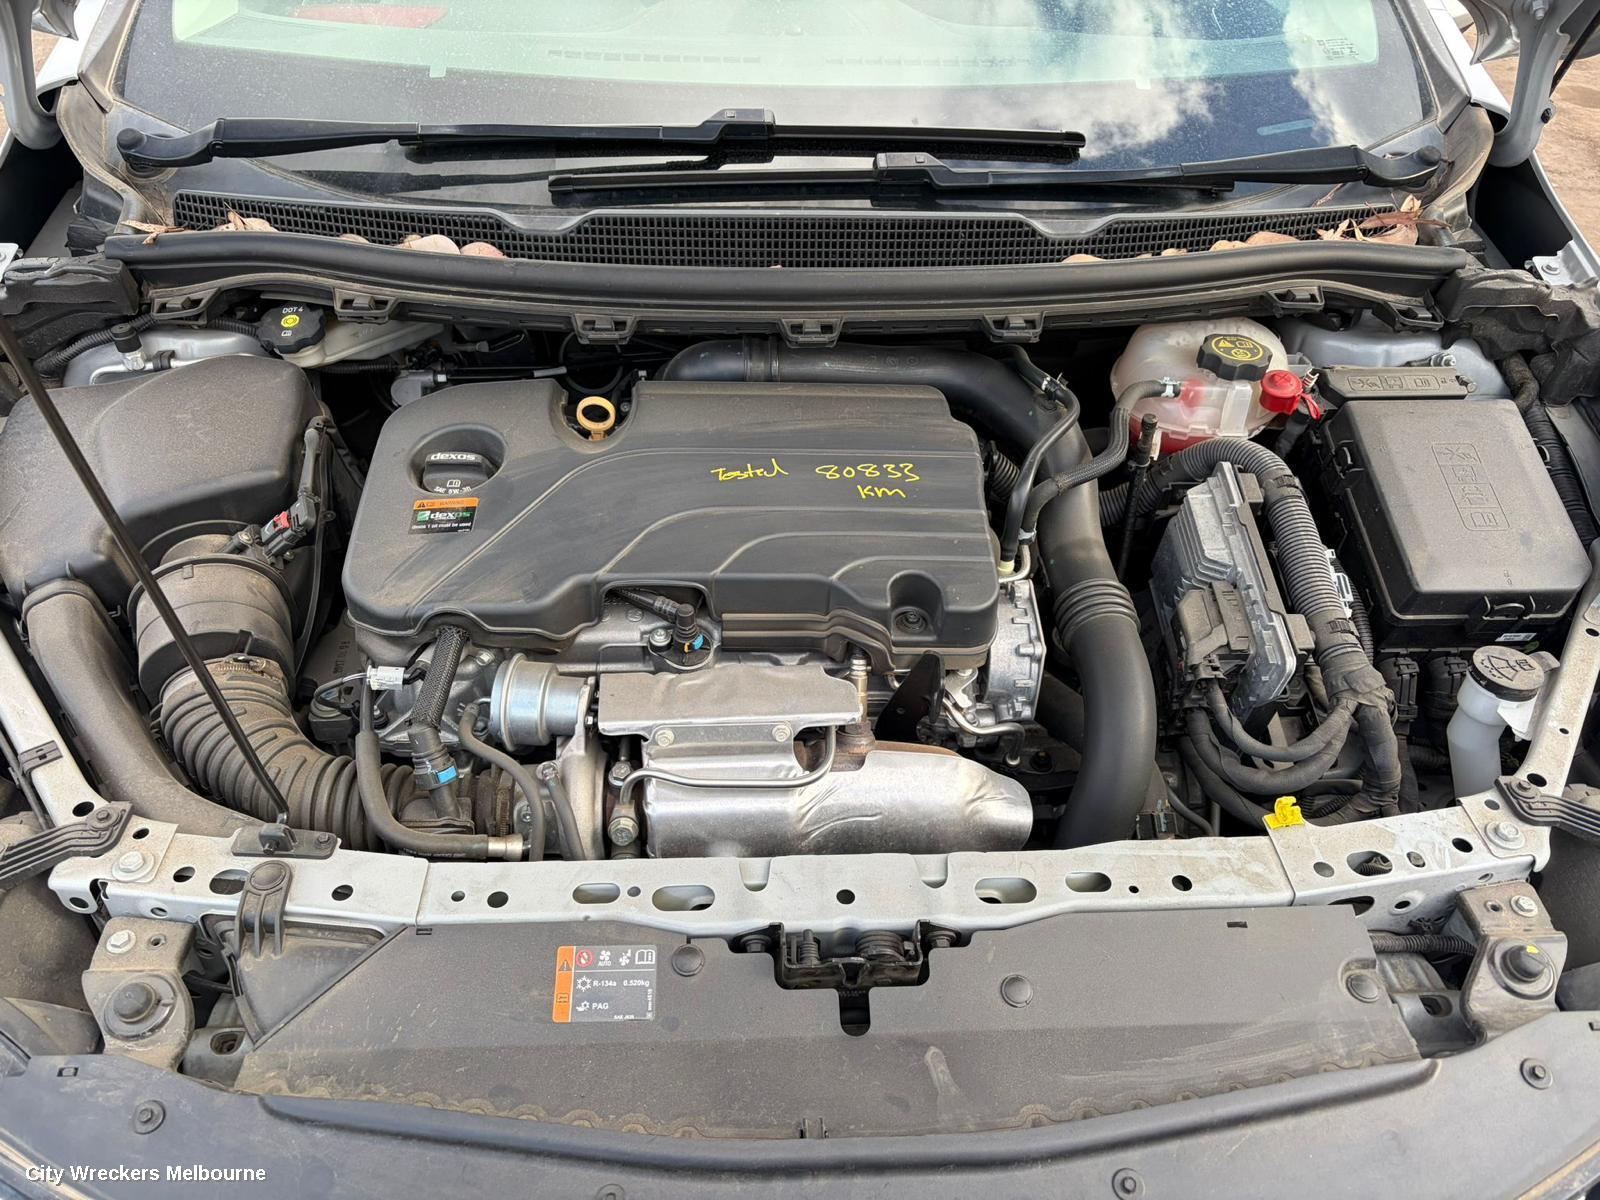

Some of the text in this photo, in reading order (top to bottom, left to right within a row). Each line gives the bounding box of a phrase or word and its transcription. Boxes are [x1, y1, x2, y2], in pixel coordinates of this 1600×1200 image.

[282, 306, 298, 314] DOT
[430, 452, 476, 461] dexos
[711, 458, 920, 482] Tested 80833
[430, 511, 473, 520] dexos
[623, 980, 650, 988] 0.520kg
[592, 1002, 609, 1010] PAG
